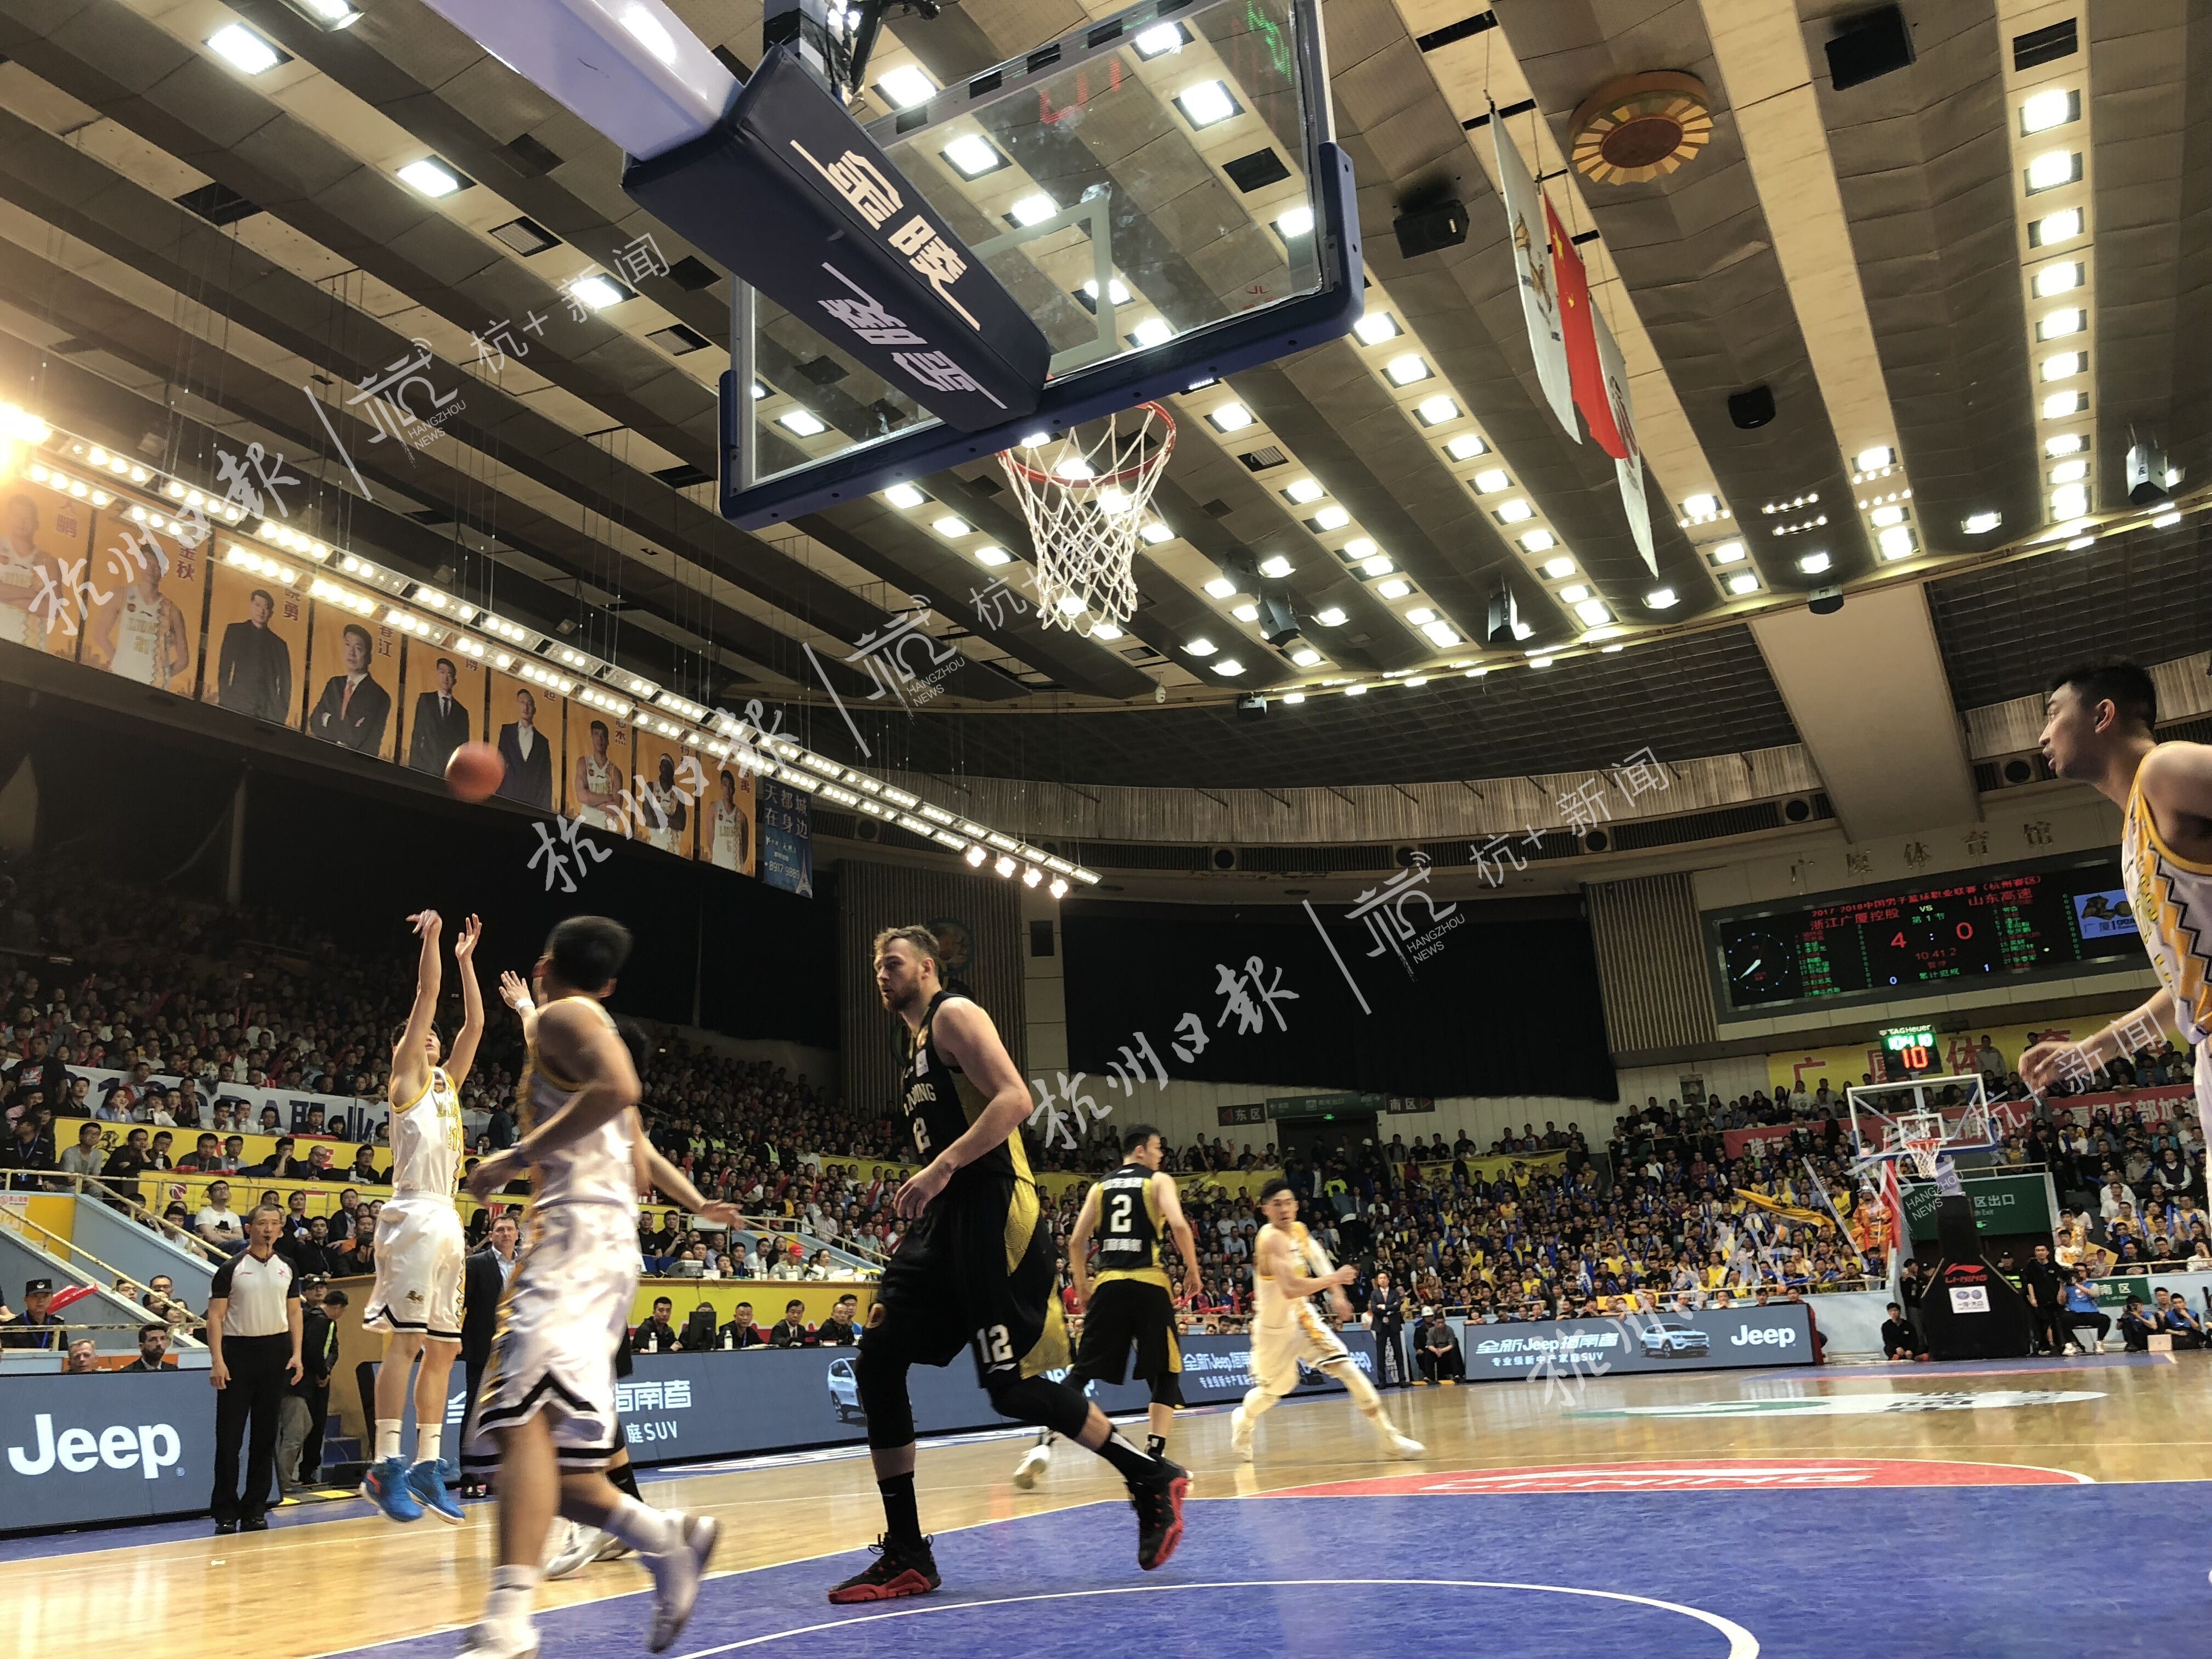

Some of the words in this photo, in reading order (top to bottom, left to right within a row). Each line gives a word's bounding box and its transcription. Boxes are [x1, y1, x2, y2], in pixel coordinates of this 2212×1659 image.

[1891, 932, 1907, 949] 4
[1955, 922, 1973, 940] 0
[1900, 1045, 1928, 1069] 10
[1110, 1194, 1132, 1233] 2
[976, 1323, 1014, 1364] 12
[1730, 1324, 1796, 1348] Jeep
[8, 1413, 182, 1480] Jeep
